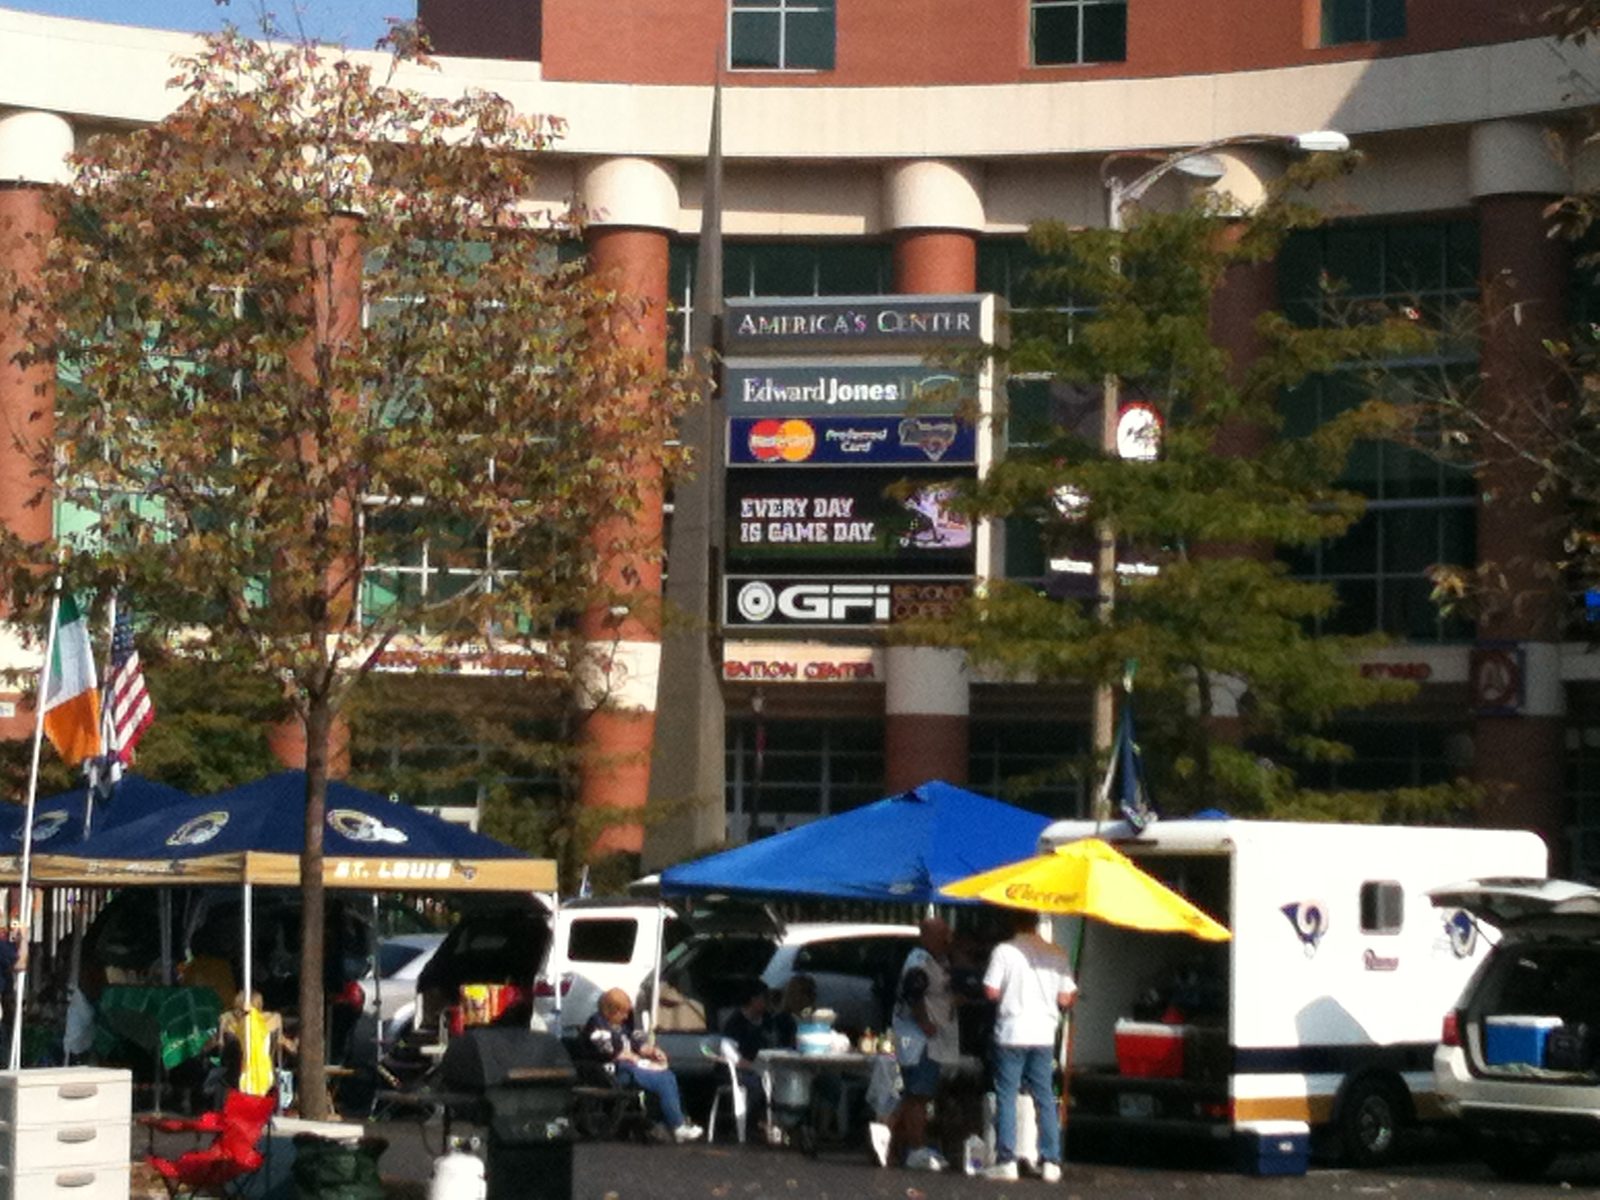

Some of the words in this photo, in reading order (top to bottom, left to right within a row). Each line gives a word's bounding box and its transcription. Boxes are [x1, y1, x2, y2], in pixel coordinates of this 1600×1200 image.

[738, 311, 867, 335] AMERICA'S
[877, 310, 971, 333] CENTER
[841, 440, 872, 453] Card
[741, 498, 808, 518] EVERY
[813, 498, 854, 518] DAY
[741, 522, 761, 542] IS
[768, 522, 828, 542] GAME
[833, 522, 877, 542] DAY.
[378, 861, 451, 879] LOUIS
